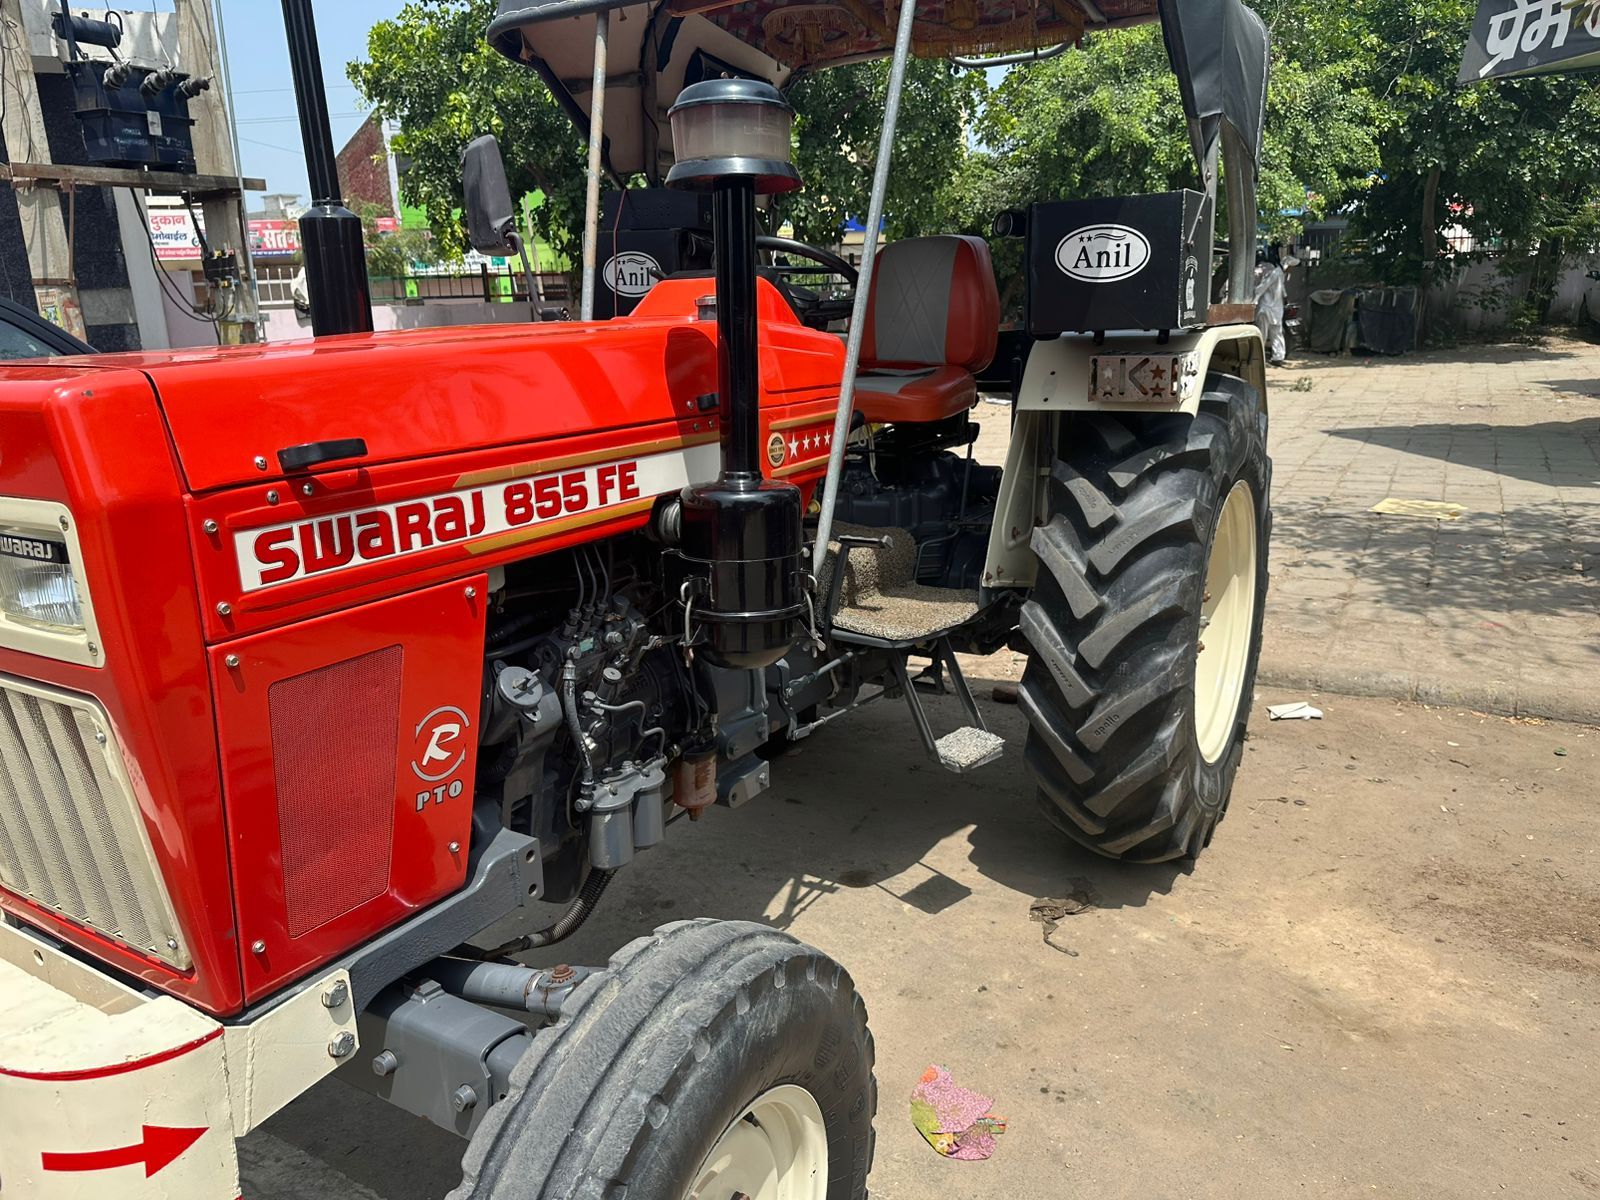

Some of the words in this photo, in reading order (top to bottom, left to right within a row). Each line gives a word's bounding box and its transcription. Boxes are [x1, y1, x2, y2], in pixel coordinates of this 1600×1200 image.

[150, 214, 186, 231] दुकान
[1072, 242, 1131, 269] Anil
[615, 266, 652, 287] Anil
[503, 470, 589, 527] 855
[597, 461, 640, 508] FE
[1094, 714, 1120, 736] apollo
[421, 723, 461, 767] R
[415, 779, 465, 812] PTO
